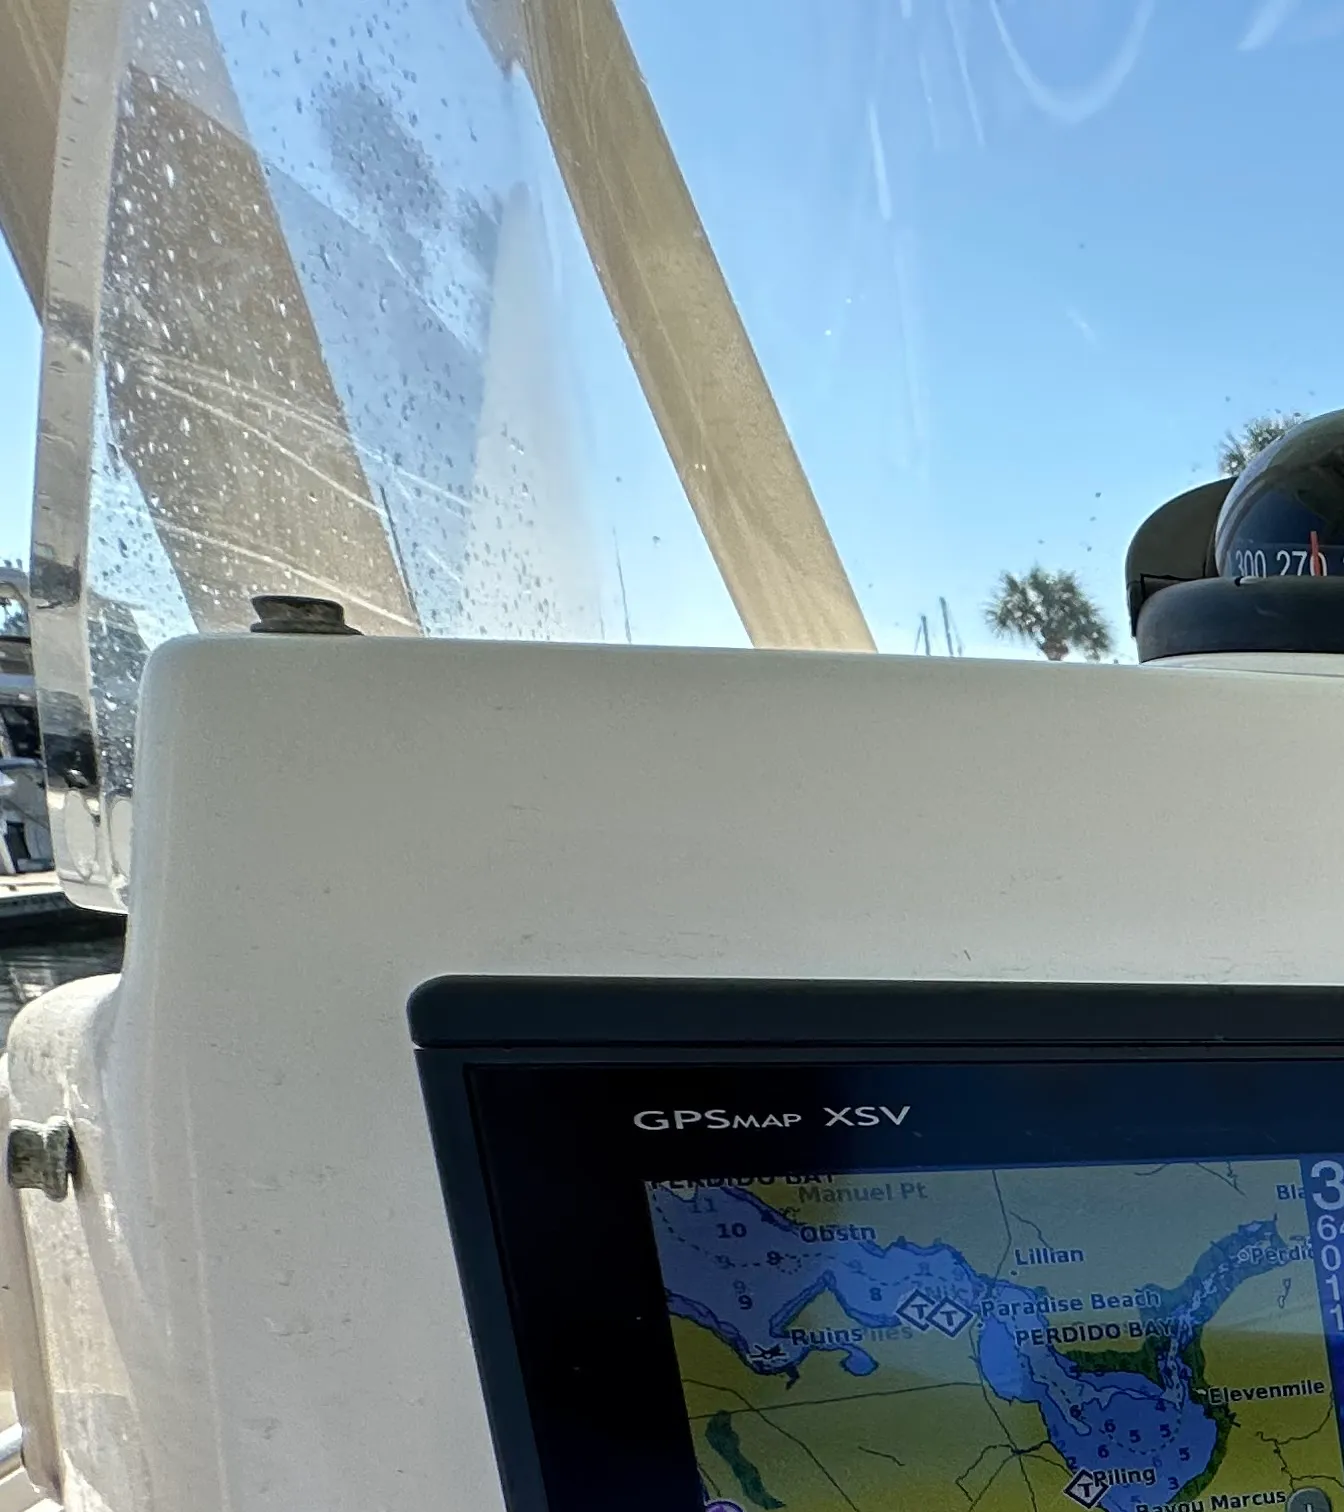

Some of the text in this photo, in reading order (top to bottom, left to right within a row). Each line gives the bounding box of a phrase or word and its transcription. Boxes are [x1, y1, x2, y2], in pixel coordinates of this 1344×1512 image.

[1236, 549, 1266, 577] 300
[1276, 550, 1326, 577] 270
[822, 1106, 911, 1127] XSV
[716, 1223, 748, 1239] 10
[799, 1224, 878, 1244] Obstn
[1014, 1247, 1085, 1266] Lillian
[979, 1288, 1161, 1318] Paradise Beach
[790, 1327, 864, 1346] Ruins
[1014, 1321, 1121, 1347] PERDIDO
[1209, 1378, 1326, 1405] Elevenmile
[1092, 1466, 1157, 1488] Piling
[1211, 1489, 1287, 1512] Marcus
